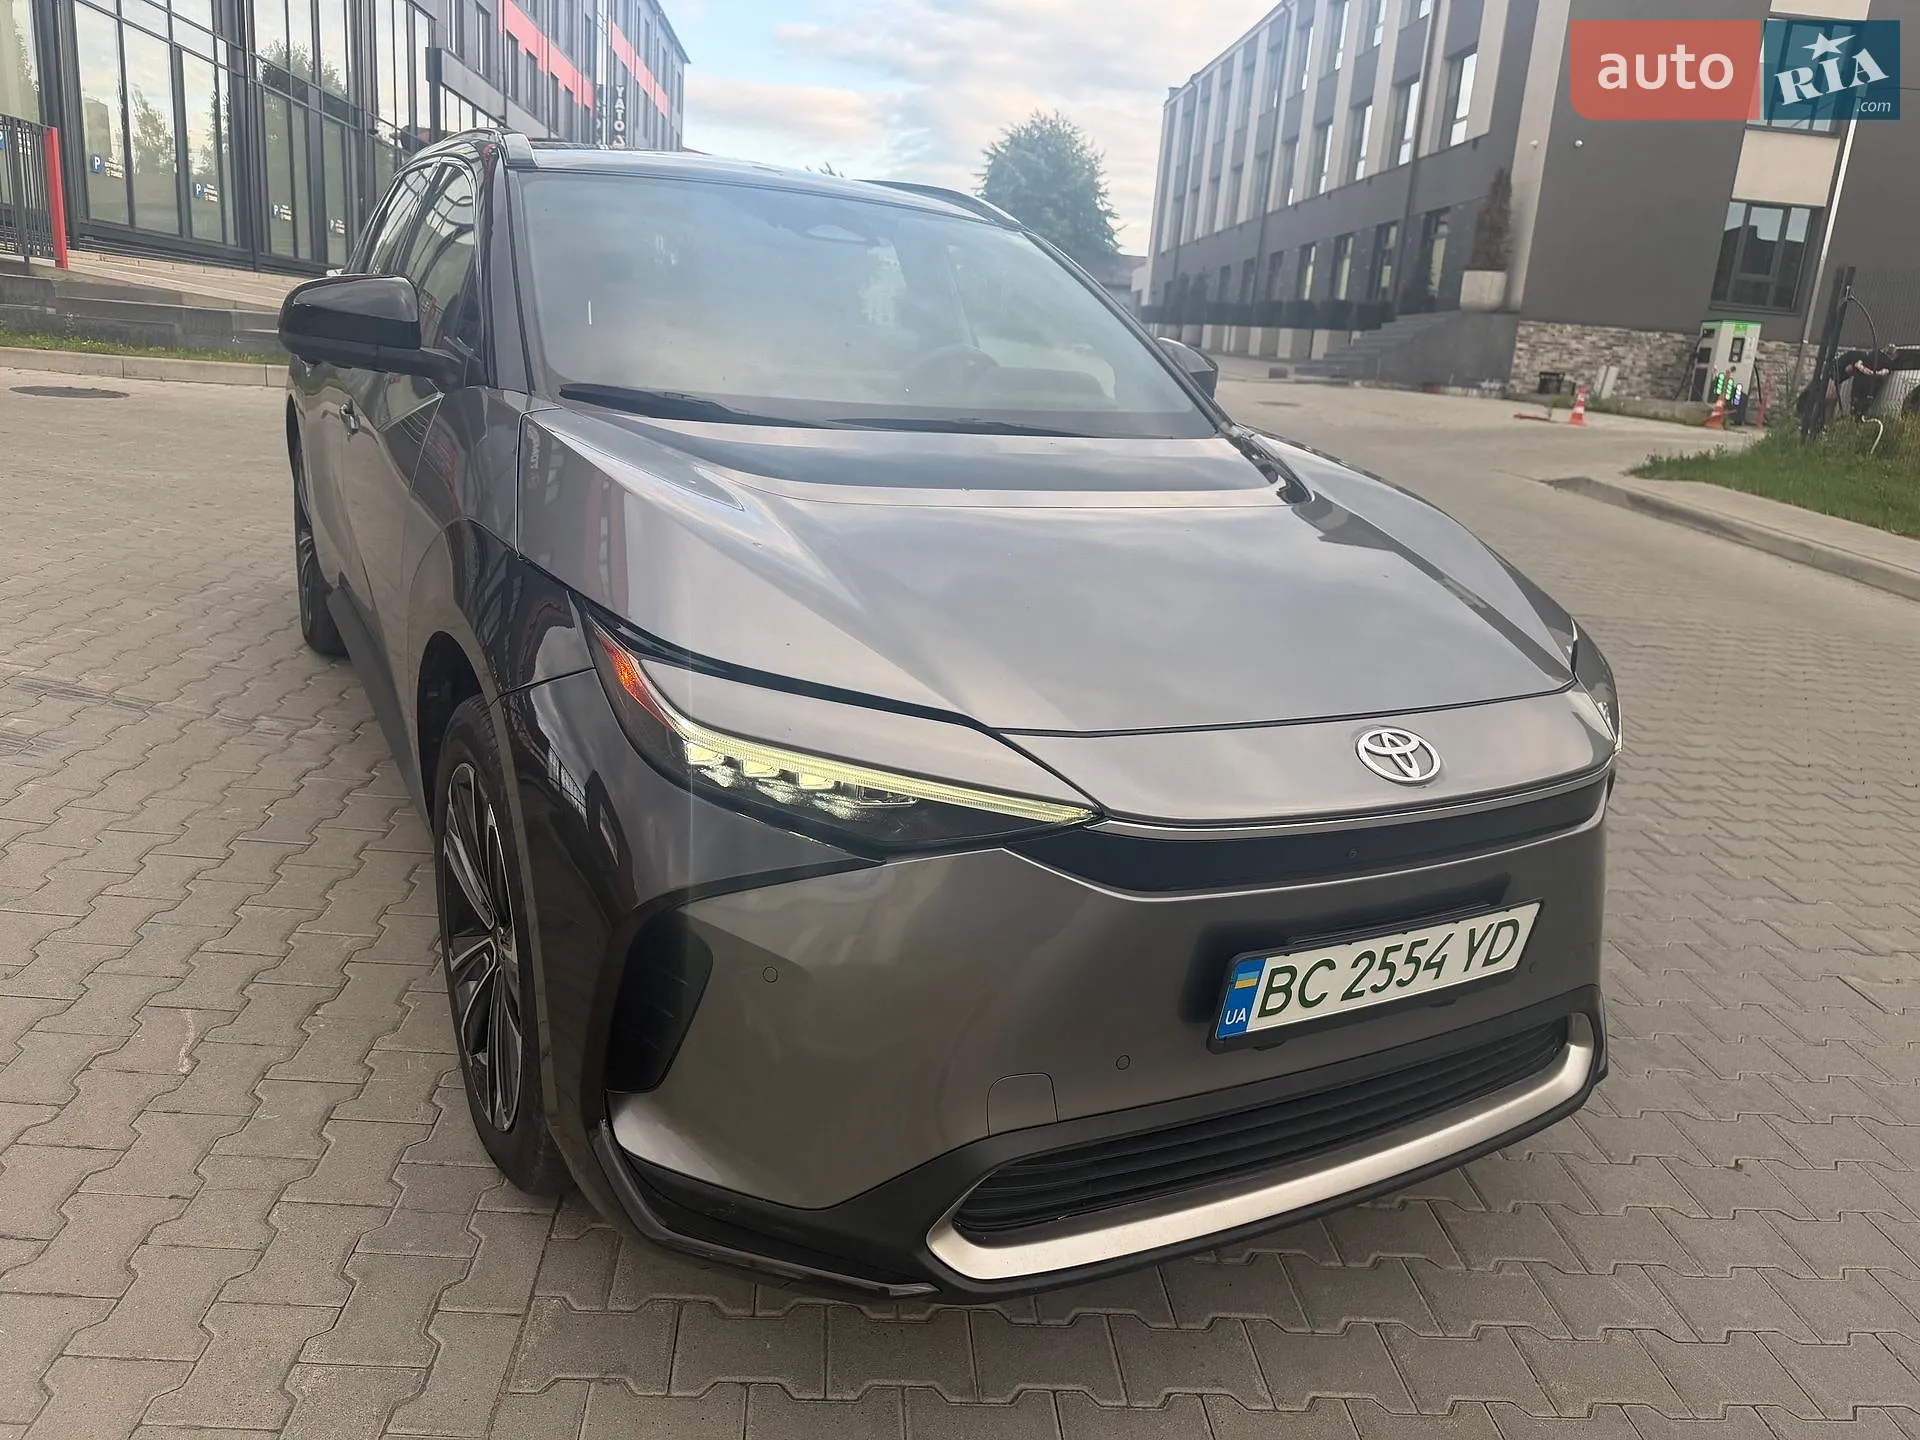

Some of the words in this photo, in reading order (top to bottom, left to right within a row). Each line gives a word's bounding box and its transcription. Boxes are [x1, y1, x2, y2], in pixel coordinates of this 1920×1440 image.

[1257, 958, 1336, 1018] BC
[1340, 932, 1455, 1002] 2554
[1462, 918, 1520, 972] YD
[1225, 1007, 1247, 1026] UA
